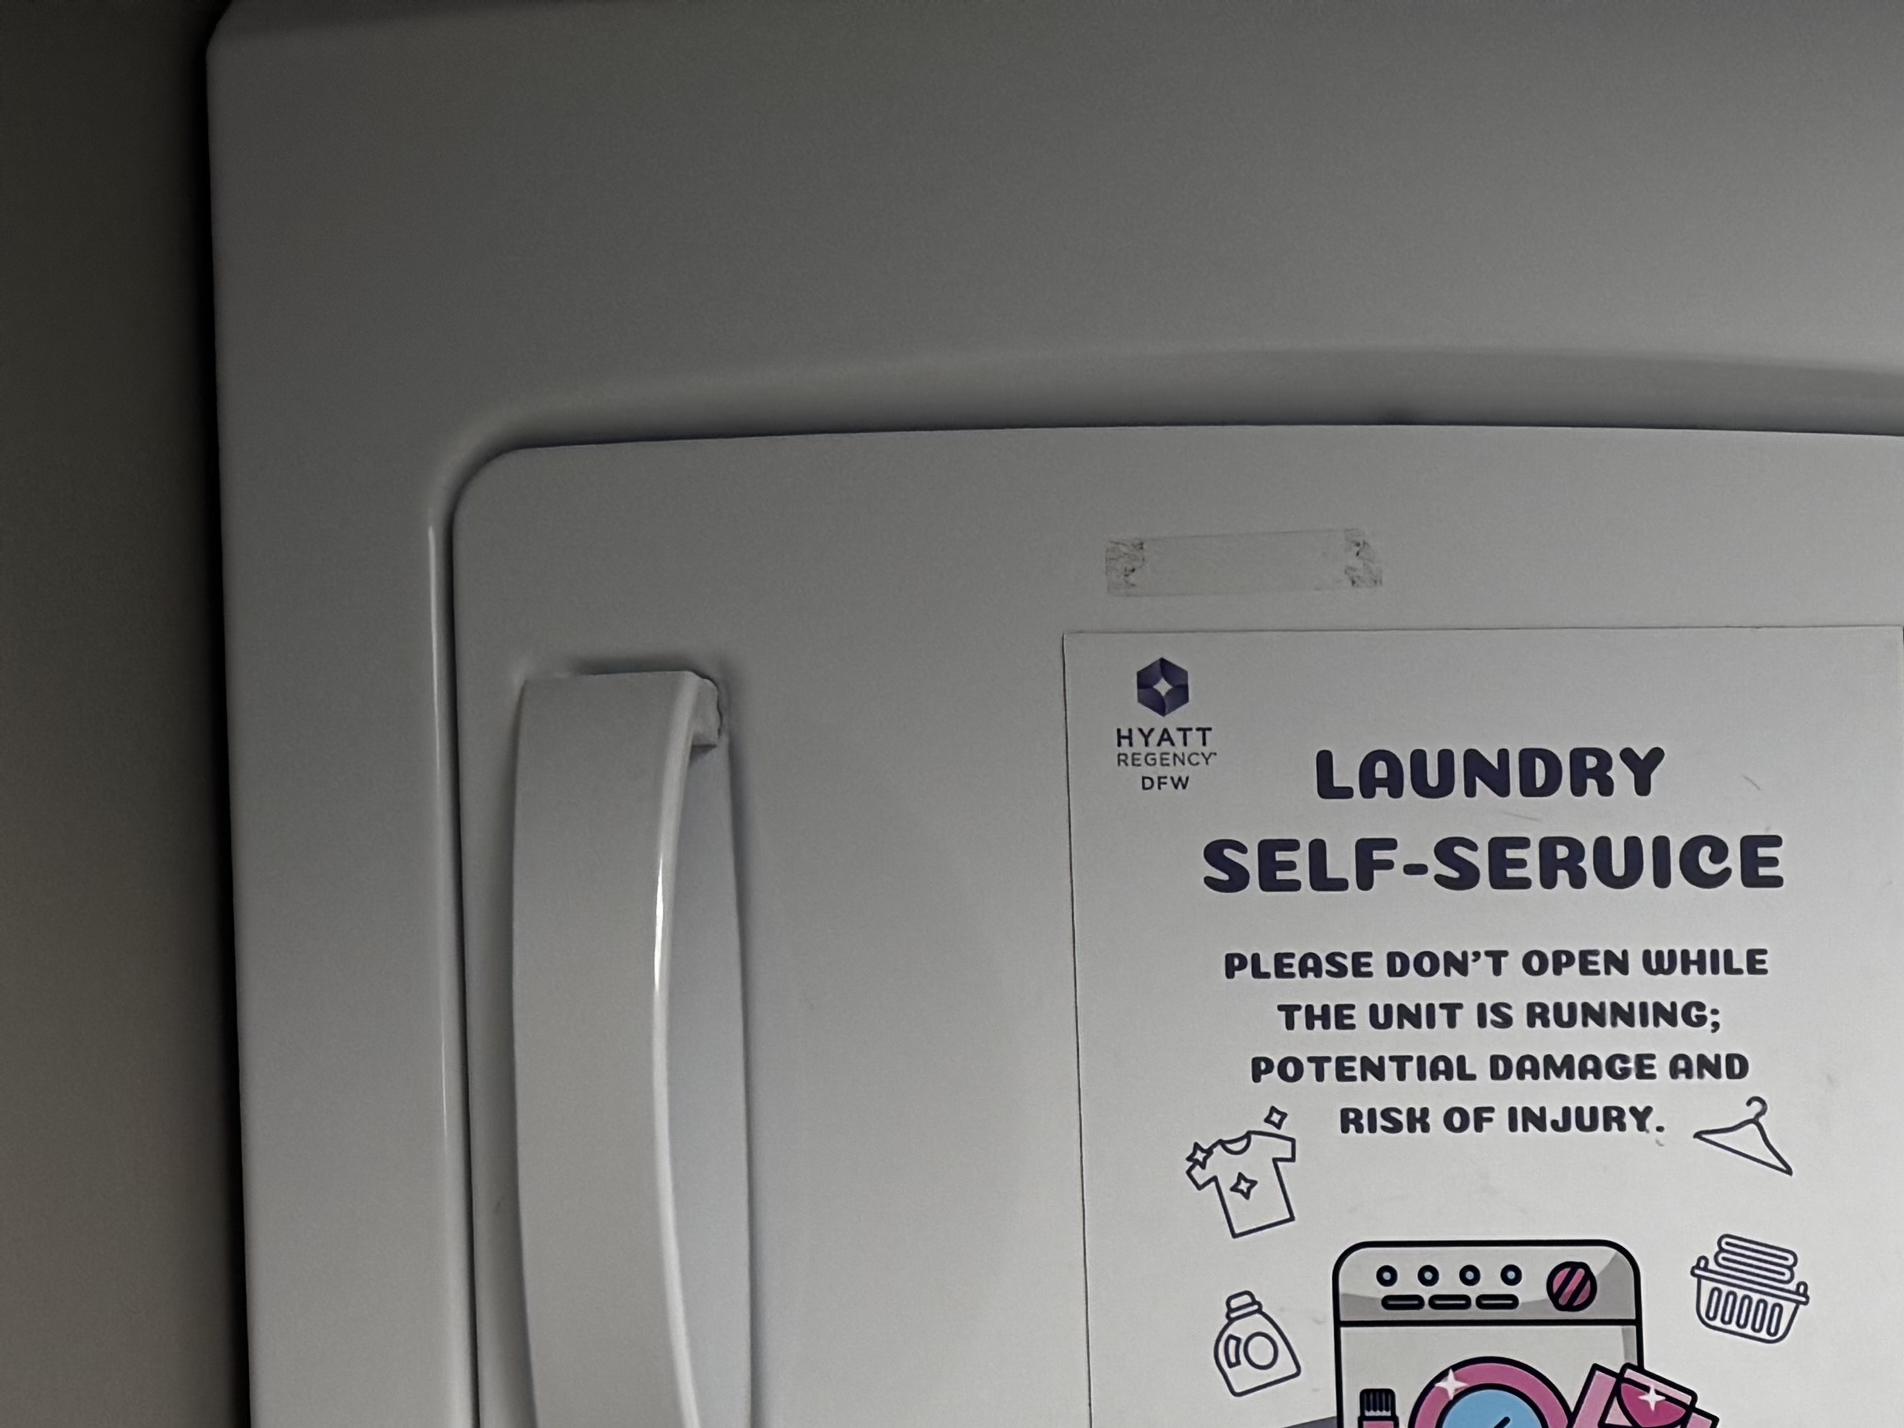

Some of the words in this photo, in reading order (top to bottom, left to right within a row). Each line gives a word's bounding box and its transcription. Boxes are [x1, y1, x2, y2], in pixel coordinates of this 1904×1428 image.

[1117, 727, 1212, 747] HYATT
[1117, 752, 1217, 767] REGENCY
[1316, 747, 1665, 799] LAUNDRY
[1142, 776, 1189, 790] DFW
[1203, 835, 1783, 893] SELF-SERVICE
[1225, 951, 1373, 979] PLEASE
[1387, 950, 1509, 977] DON'T
[1522, 949, 1629, 976] OPEN
[1642, 949, 1768, 976] WHILE
[1277, 1004, 1356, 1030] THE
[1369, 1003, 1463, 1030] UNIT
[1477, 1002, 1513, 1029] IS
[1526, 1001, 1720, 1033] RUNNING;
[1251, 1055, 1477, 1083] POTENTIAL
[1490, 1053, 1657, 1081] DAMAGE
[1669, 1053, 1749, 1080] AND
[1340, 1107, 1430, 1134] RISK
[1443, 1106, 1495, 1133] OF
[1508, 1106, 1664, 1133] INJURY.
